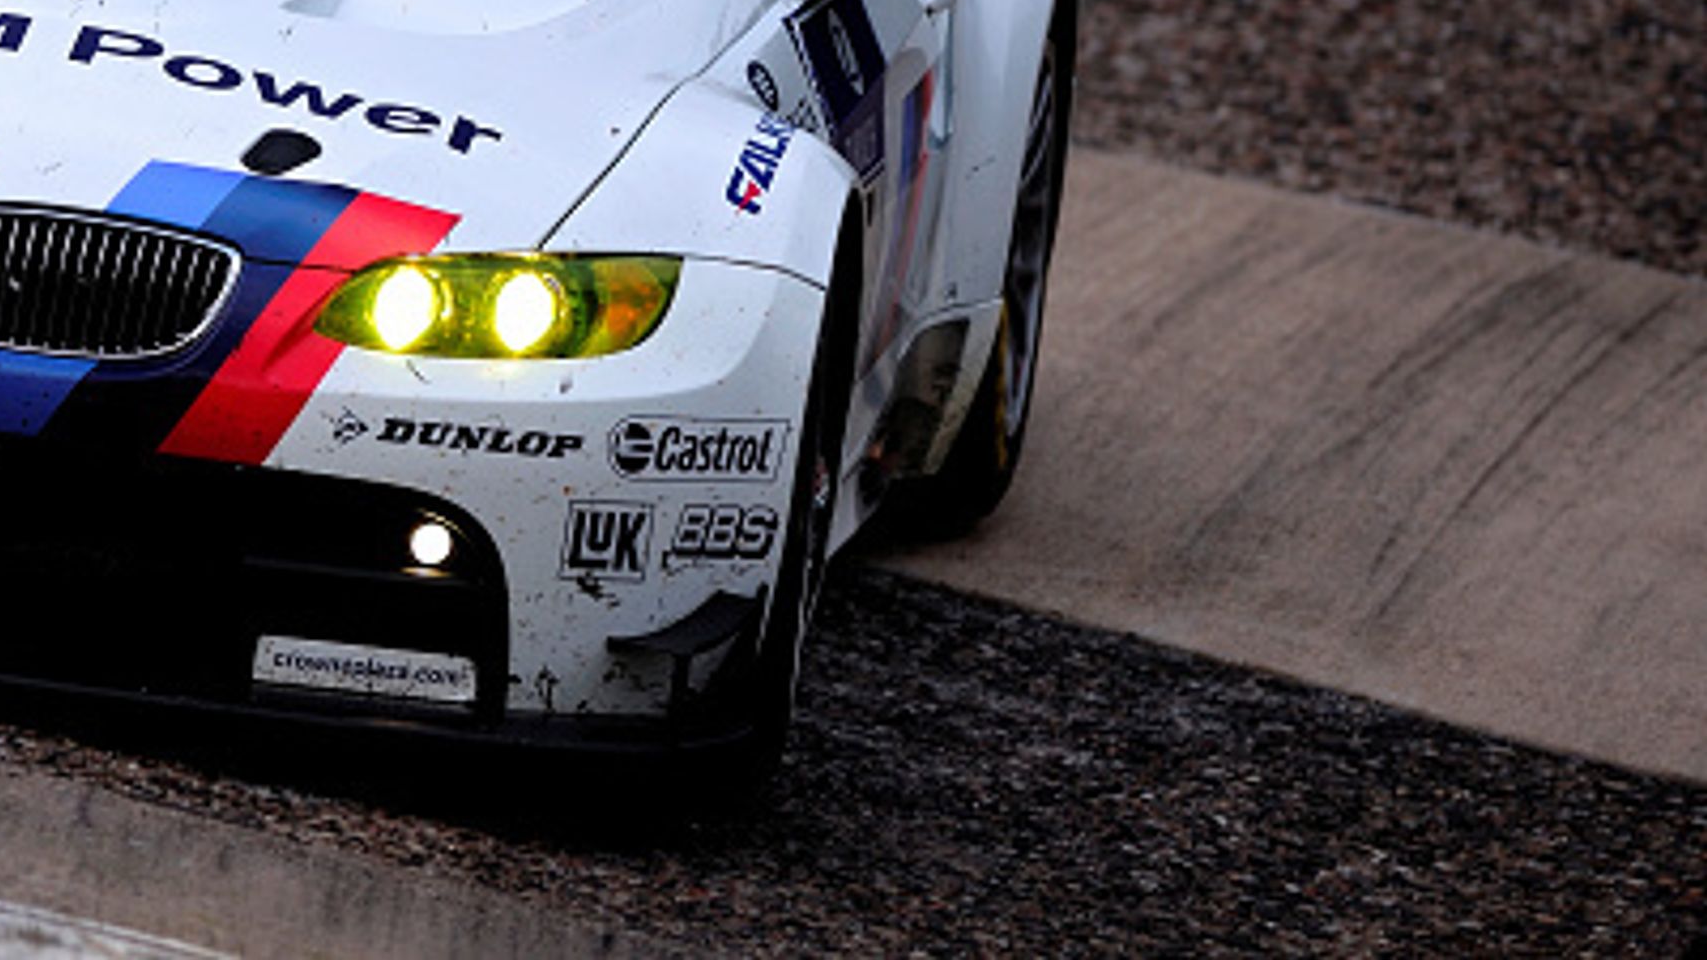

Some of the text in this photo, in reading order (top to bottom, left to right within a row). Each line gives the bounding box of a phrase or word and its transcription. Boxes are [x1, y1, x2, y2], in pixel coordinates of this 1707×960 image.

[68, 25, 503, 155] Power
[377, 418, 585, 458] DUNLOP
[654, 426, 774, 474] Castrol
[671, 503, 779, 560] BBS
